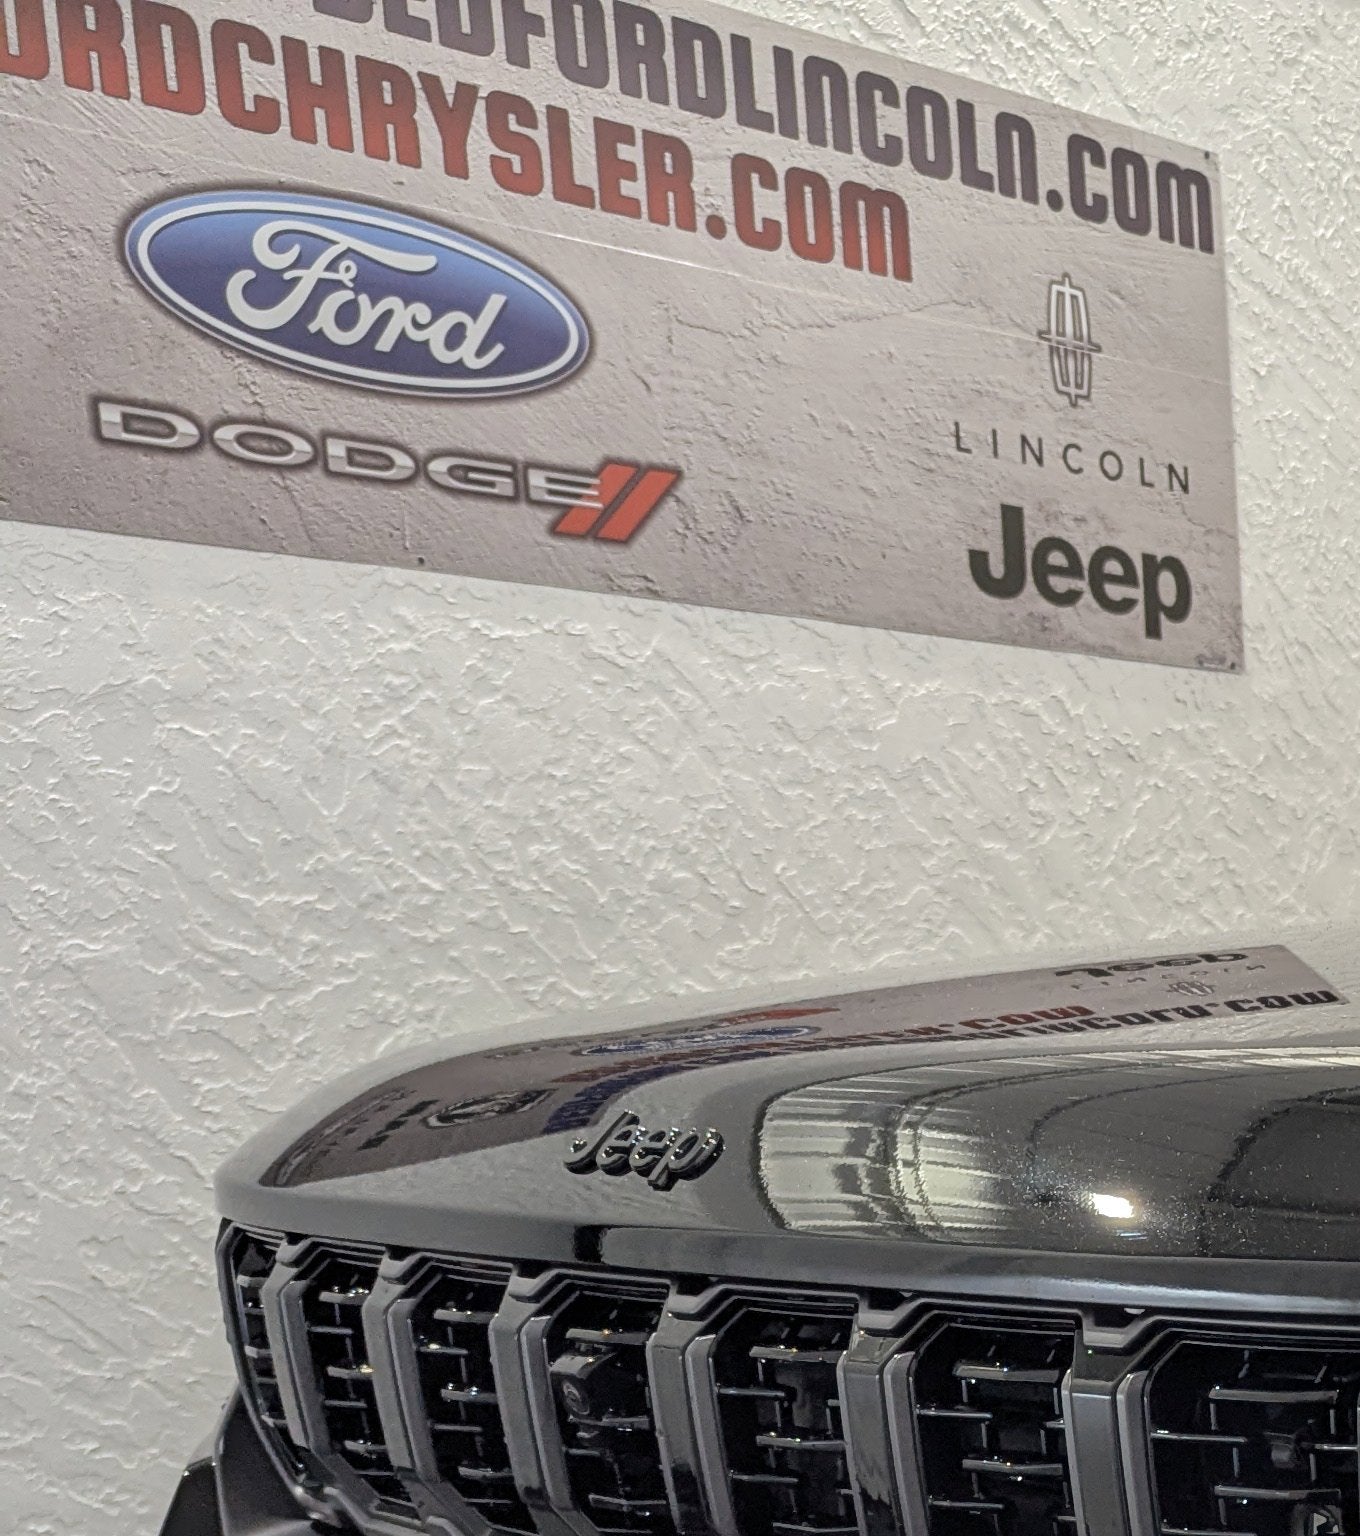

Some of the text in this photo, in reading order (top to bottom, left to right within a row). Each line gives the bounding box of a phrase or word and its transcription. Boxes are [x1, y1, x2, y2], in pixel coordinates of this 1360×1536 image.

[313, 0, 1214, 254] DFORDLINCOLN.COM
[226, 220, 505, 370] Ford
[97, 402, 605, 510] DODGE
[954, 421, 1190, 494] LINCOLN
[968, 503, 1193, 641] Jeep
[563, 1109, 726, 1192] Jeep
